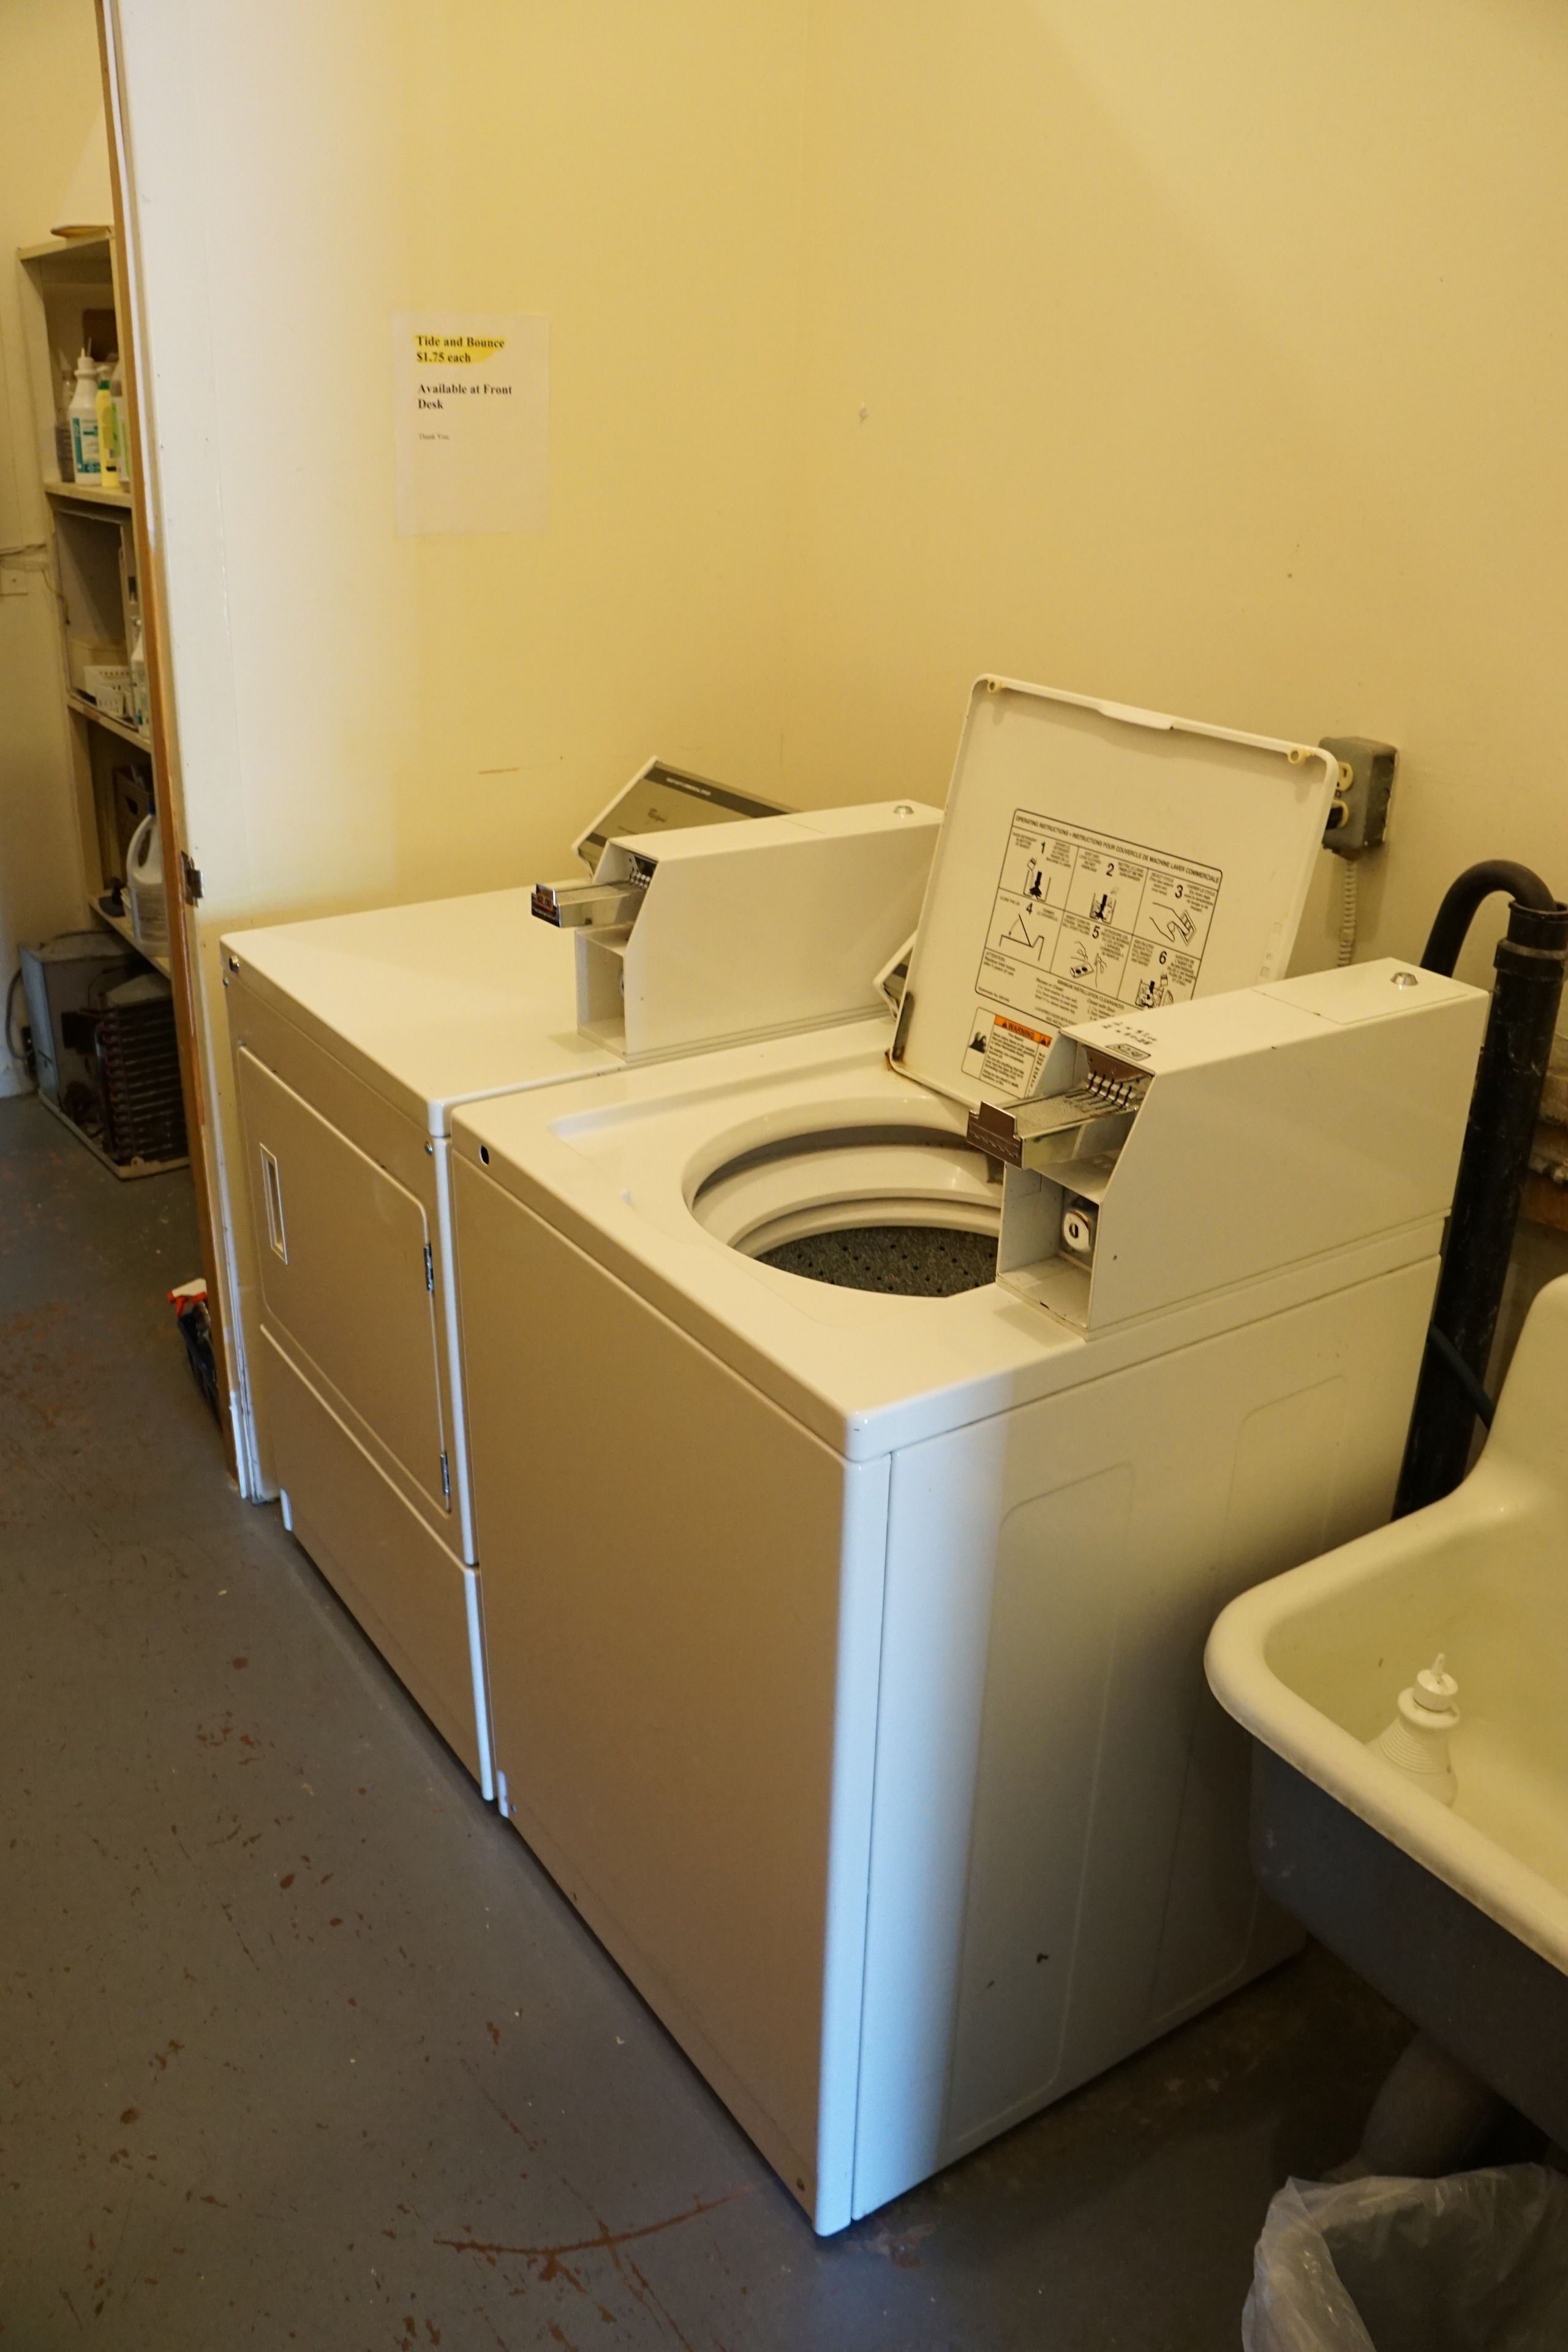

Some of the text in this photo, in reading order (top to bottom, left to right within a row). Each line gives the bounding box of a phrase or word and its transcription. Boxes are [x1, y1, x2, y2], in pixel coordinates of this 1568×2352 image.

[417, 336, 505, 349] Tide and Bounce
[417, 352, 471, 363] $1.75 each
[419, 384, 513, 395] Available at Front
[418, 399, 444, 409] Desk
[1016, 815, 1039, 827] OPERATING
[1149, 856, 1170, 867] MACHINE
[1170, 862, 1185, 872] LAVER
[1185, 867, 1219, 883] COMMERCIALE
[1039, 840, 1046, 854] 1
[1106, 862, 1115, 876] 2
[1174, 884, 1183, 899] 3
[1025, 901, 1033, 915] 4
[1091, 925, 1100, 939] 5
[1158, 950, 1167, 965] 6
[1008, 1021, 1035, 1039] WARNING
